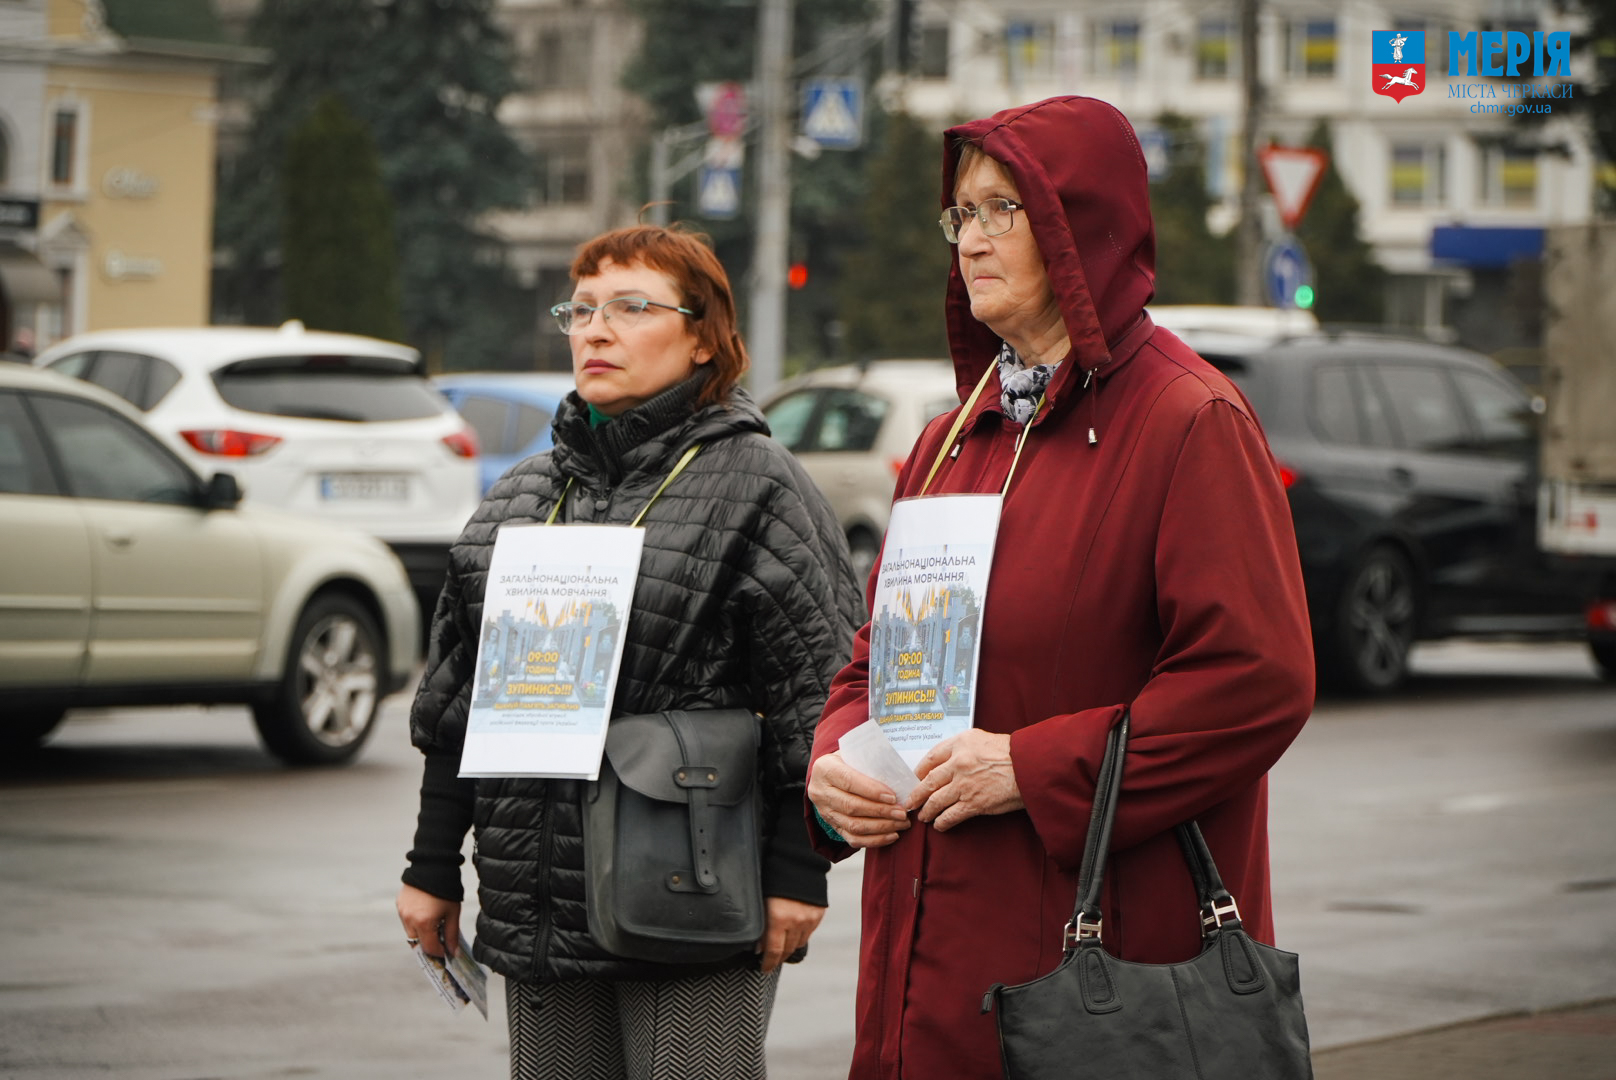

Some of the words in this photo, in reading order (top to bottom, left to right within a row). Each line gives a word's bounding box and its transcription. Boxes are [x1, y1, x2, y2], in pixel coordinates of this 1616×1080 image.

[881, 556, 976, 575] ЗАГАЛЬНОНАЦІОНАЛЬНА
[499, 574, 619, 585] ЗАГАЛЬНОНАЦІОНАЛЬНА
[884, 575, 913, 588] ХВИЛИНА
[914, 571, 965, 584] МОВЧАННЯ
[505, 587, 549, 597] ХВИЛИНА
[551, 588, 608, 598] МОВЧАННЯ
[527, 650, 559, 664] 09:00
[898, 651, 923, 667] 09:00
[897, 668, 921, 681] ГОДИНА
[506, 682, 574, 696] ЗУПИНИСЬ!!!
[885, 688, 937, 706] ЗУПИНИСЬ!!!
